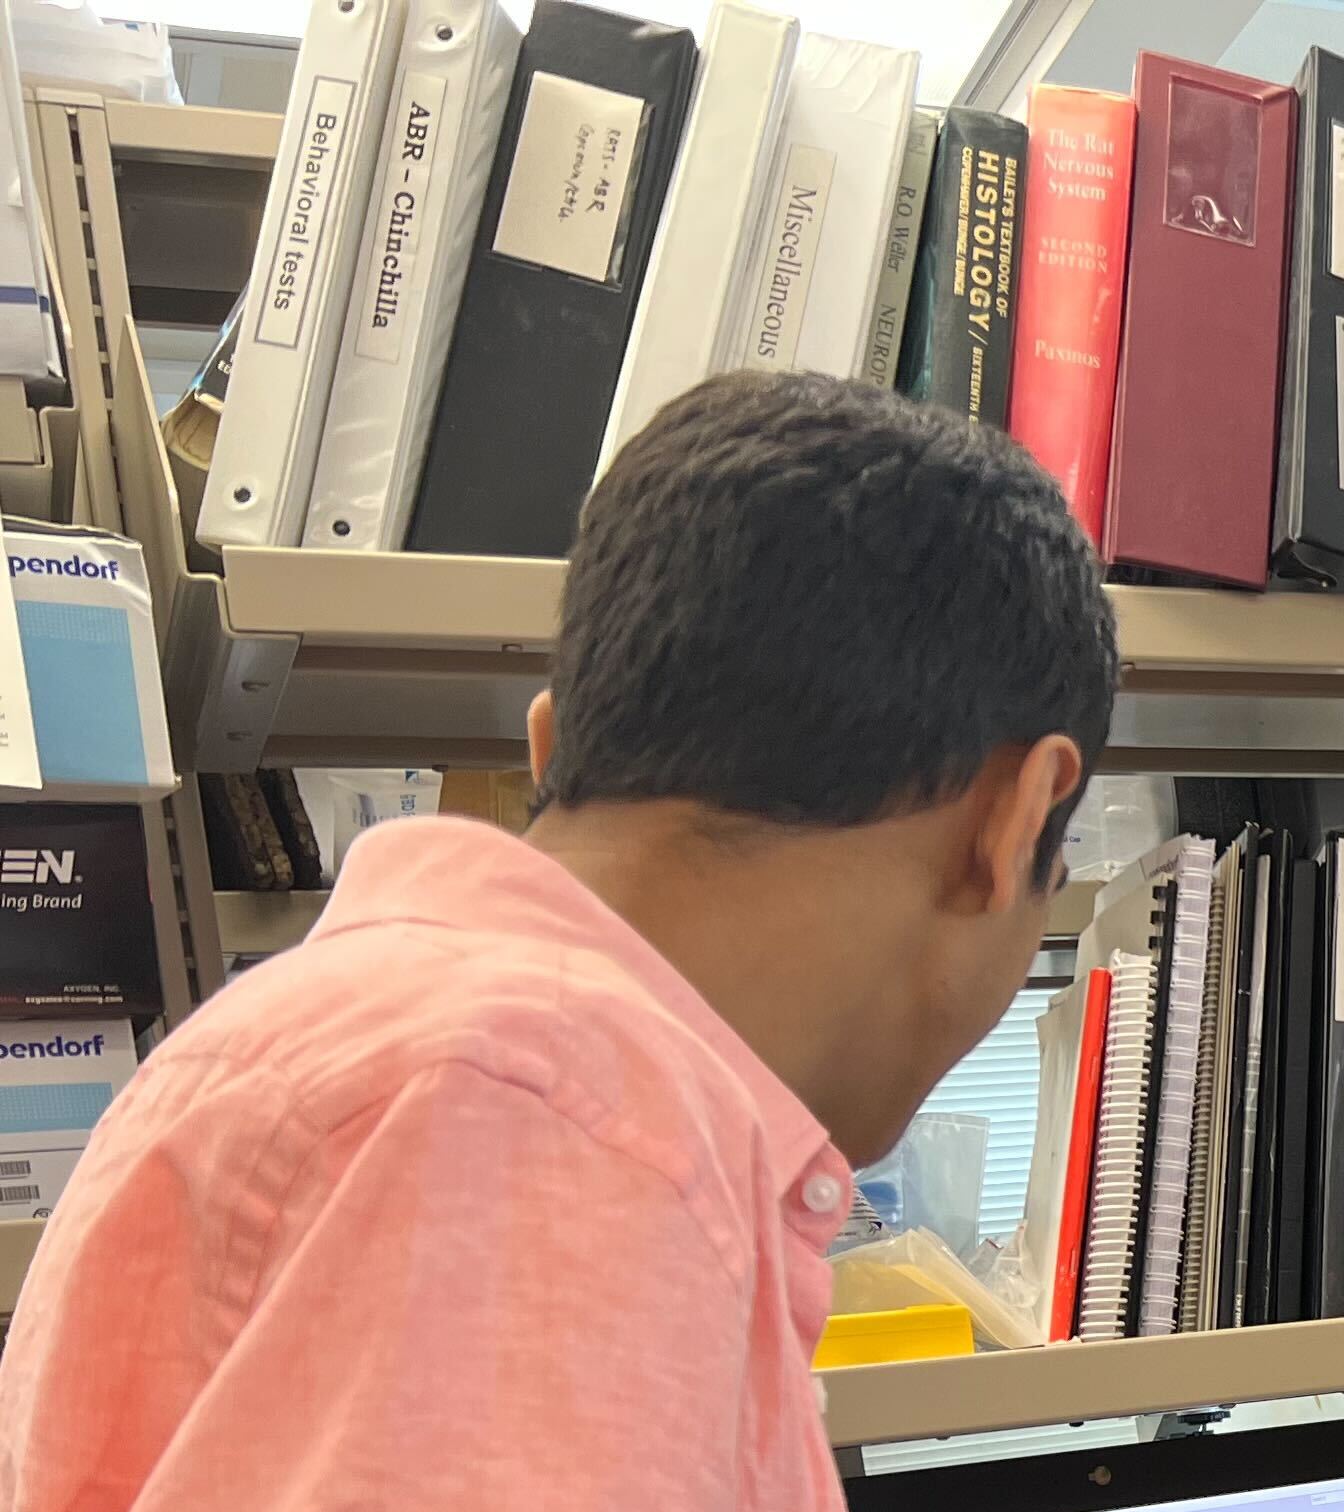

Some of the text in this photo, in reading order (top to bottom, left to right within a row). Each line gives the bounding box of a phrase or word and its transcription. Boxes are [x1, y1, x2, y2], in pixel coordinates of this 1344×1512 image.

[403, 101, 430, 160] ABR
[1048, 128, 1078, 149] The
[1044, 152, 1114, 180] Nervous
[1047, 179, 1107, 201] System
[272, 112, 336, 310] Behavioral tests
[888, 227, 910, 272] Weller
[969, 150, 1000, 332] HISTOLOGY
[998, 221, 1013, 296] TEXTBOOK
[372, 190, 414, 329] Chinchilla
[758, 185, 817, 359] Miscellaneous
[1038, 251, 1108, 273] EDITION
[996, 298, 1008, 318] OF
[8, 554, 119, 581] pendorf
[32, 894, 82, 909] Brand
